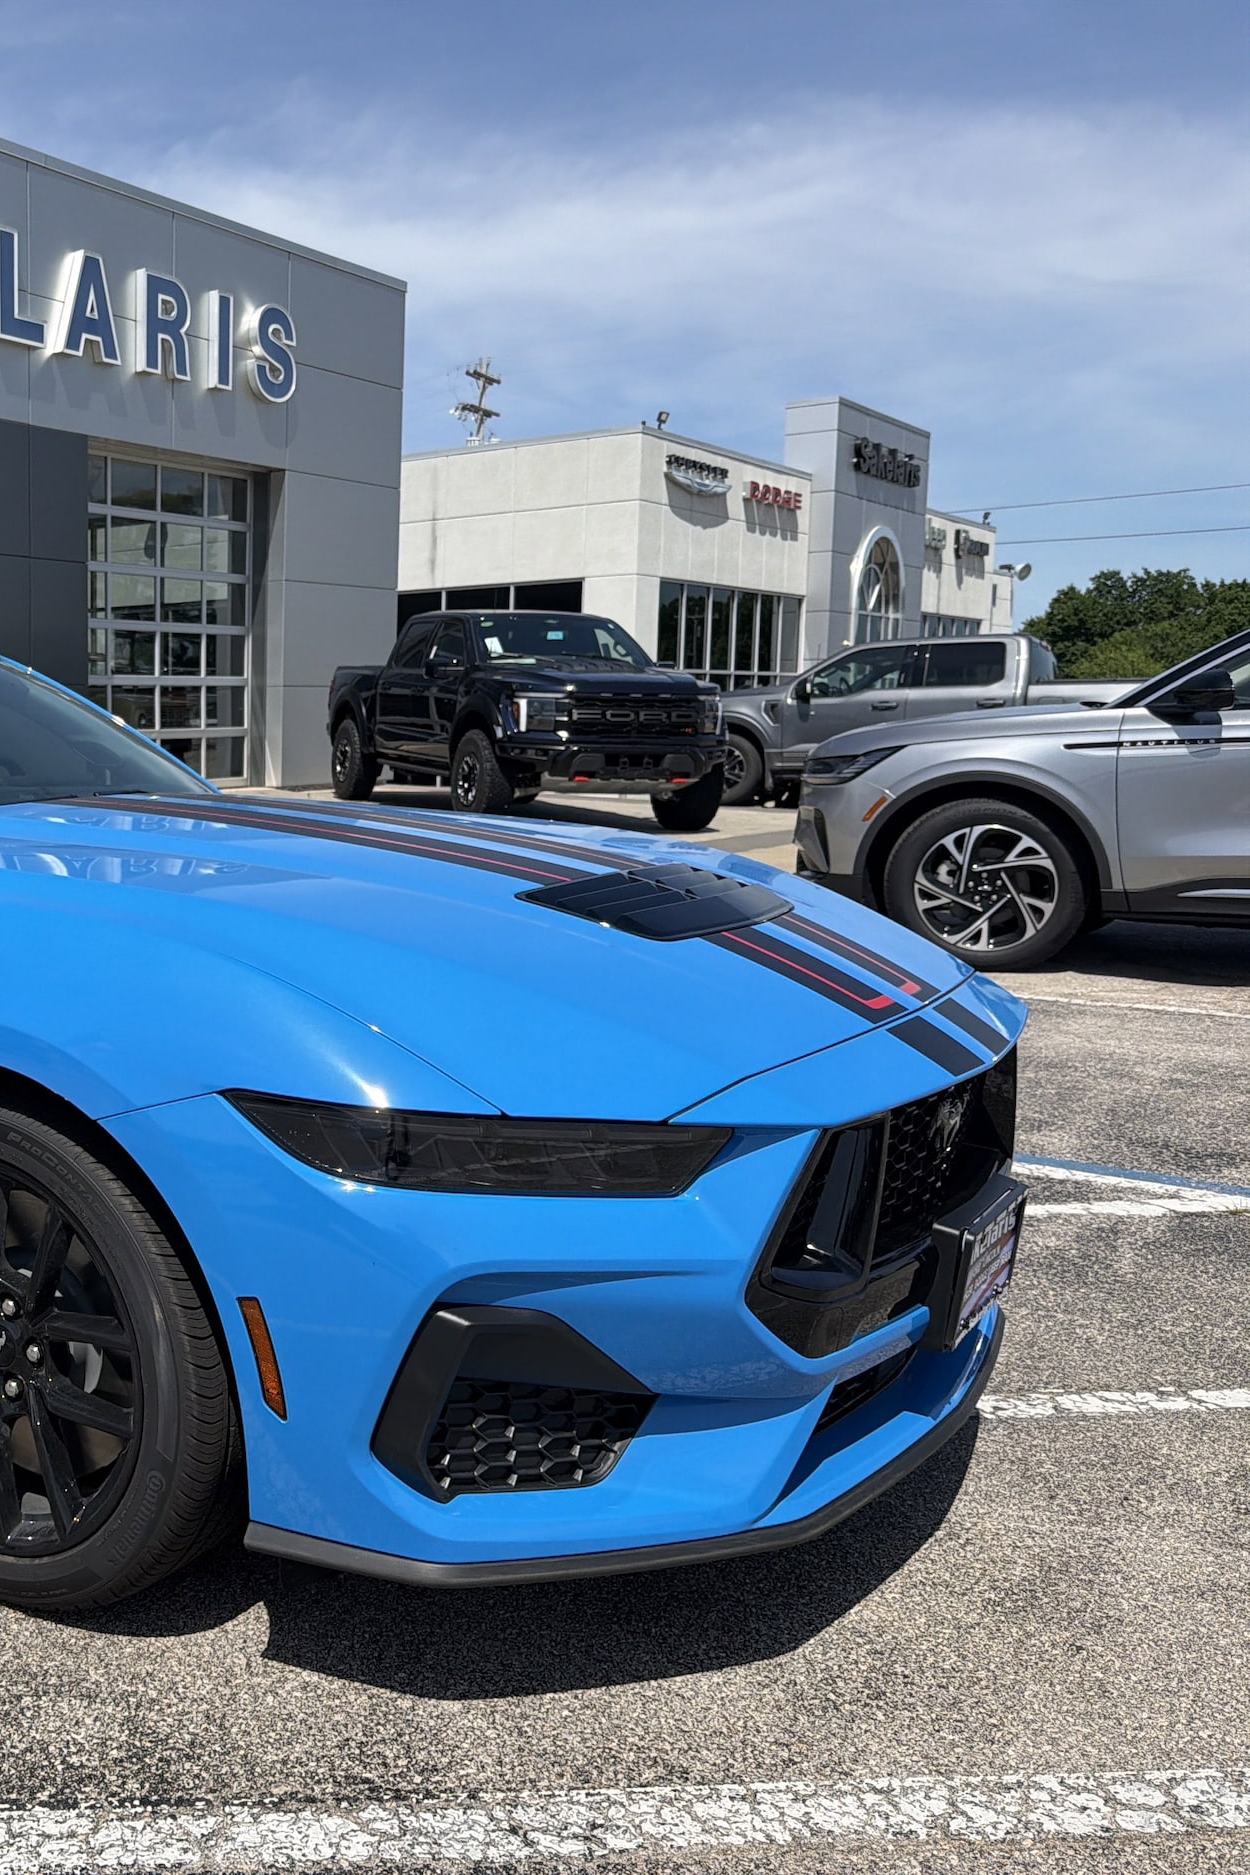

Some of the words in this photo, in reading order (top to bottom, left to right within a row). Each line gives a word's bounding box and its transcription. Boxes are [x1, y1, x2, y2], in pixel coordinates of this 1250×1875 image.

[748, 481, 802, 510] DODGE
[571, 707, 698, 723] FORD
[1122, 739, 1216, 748] NAUTILUS
